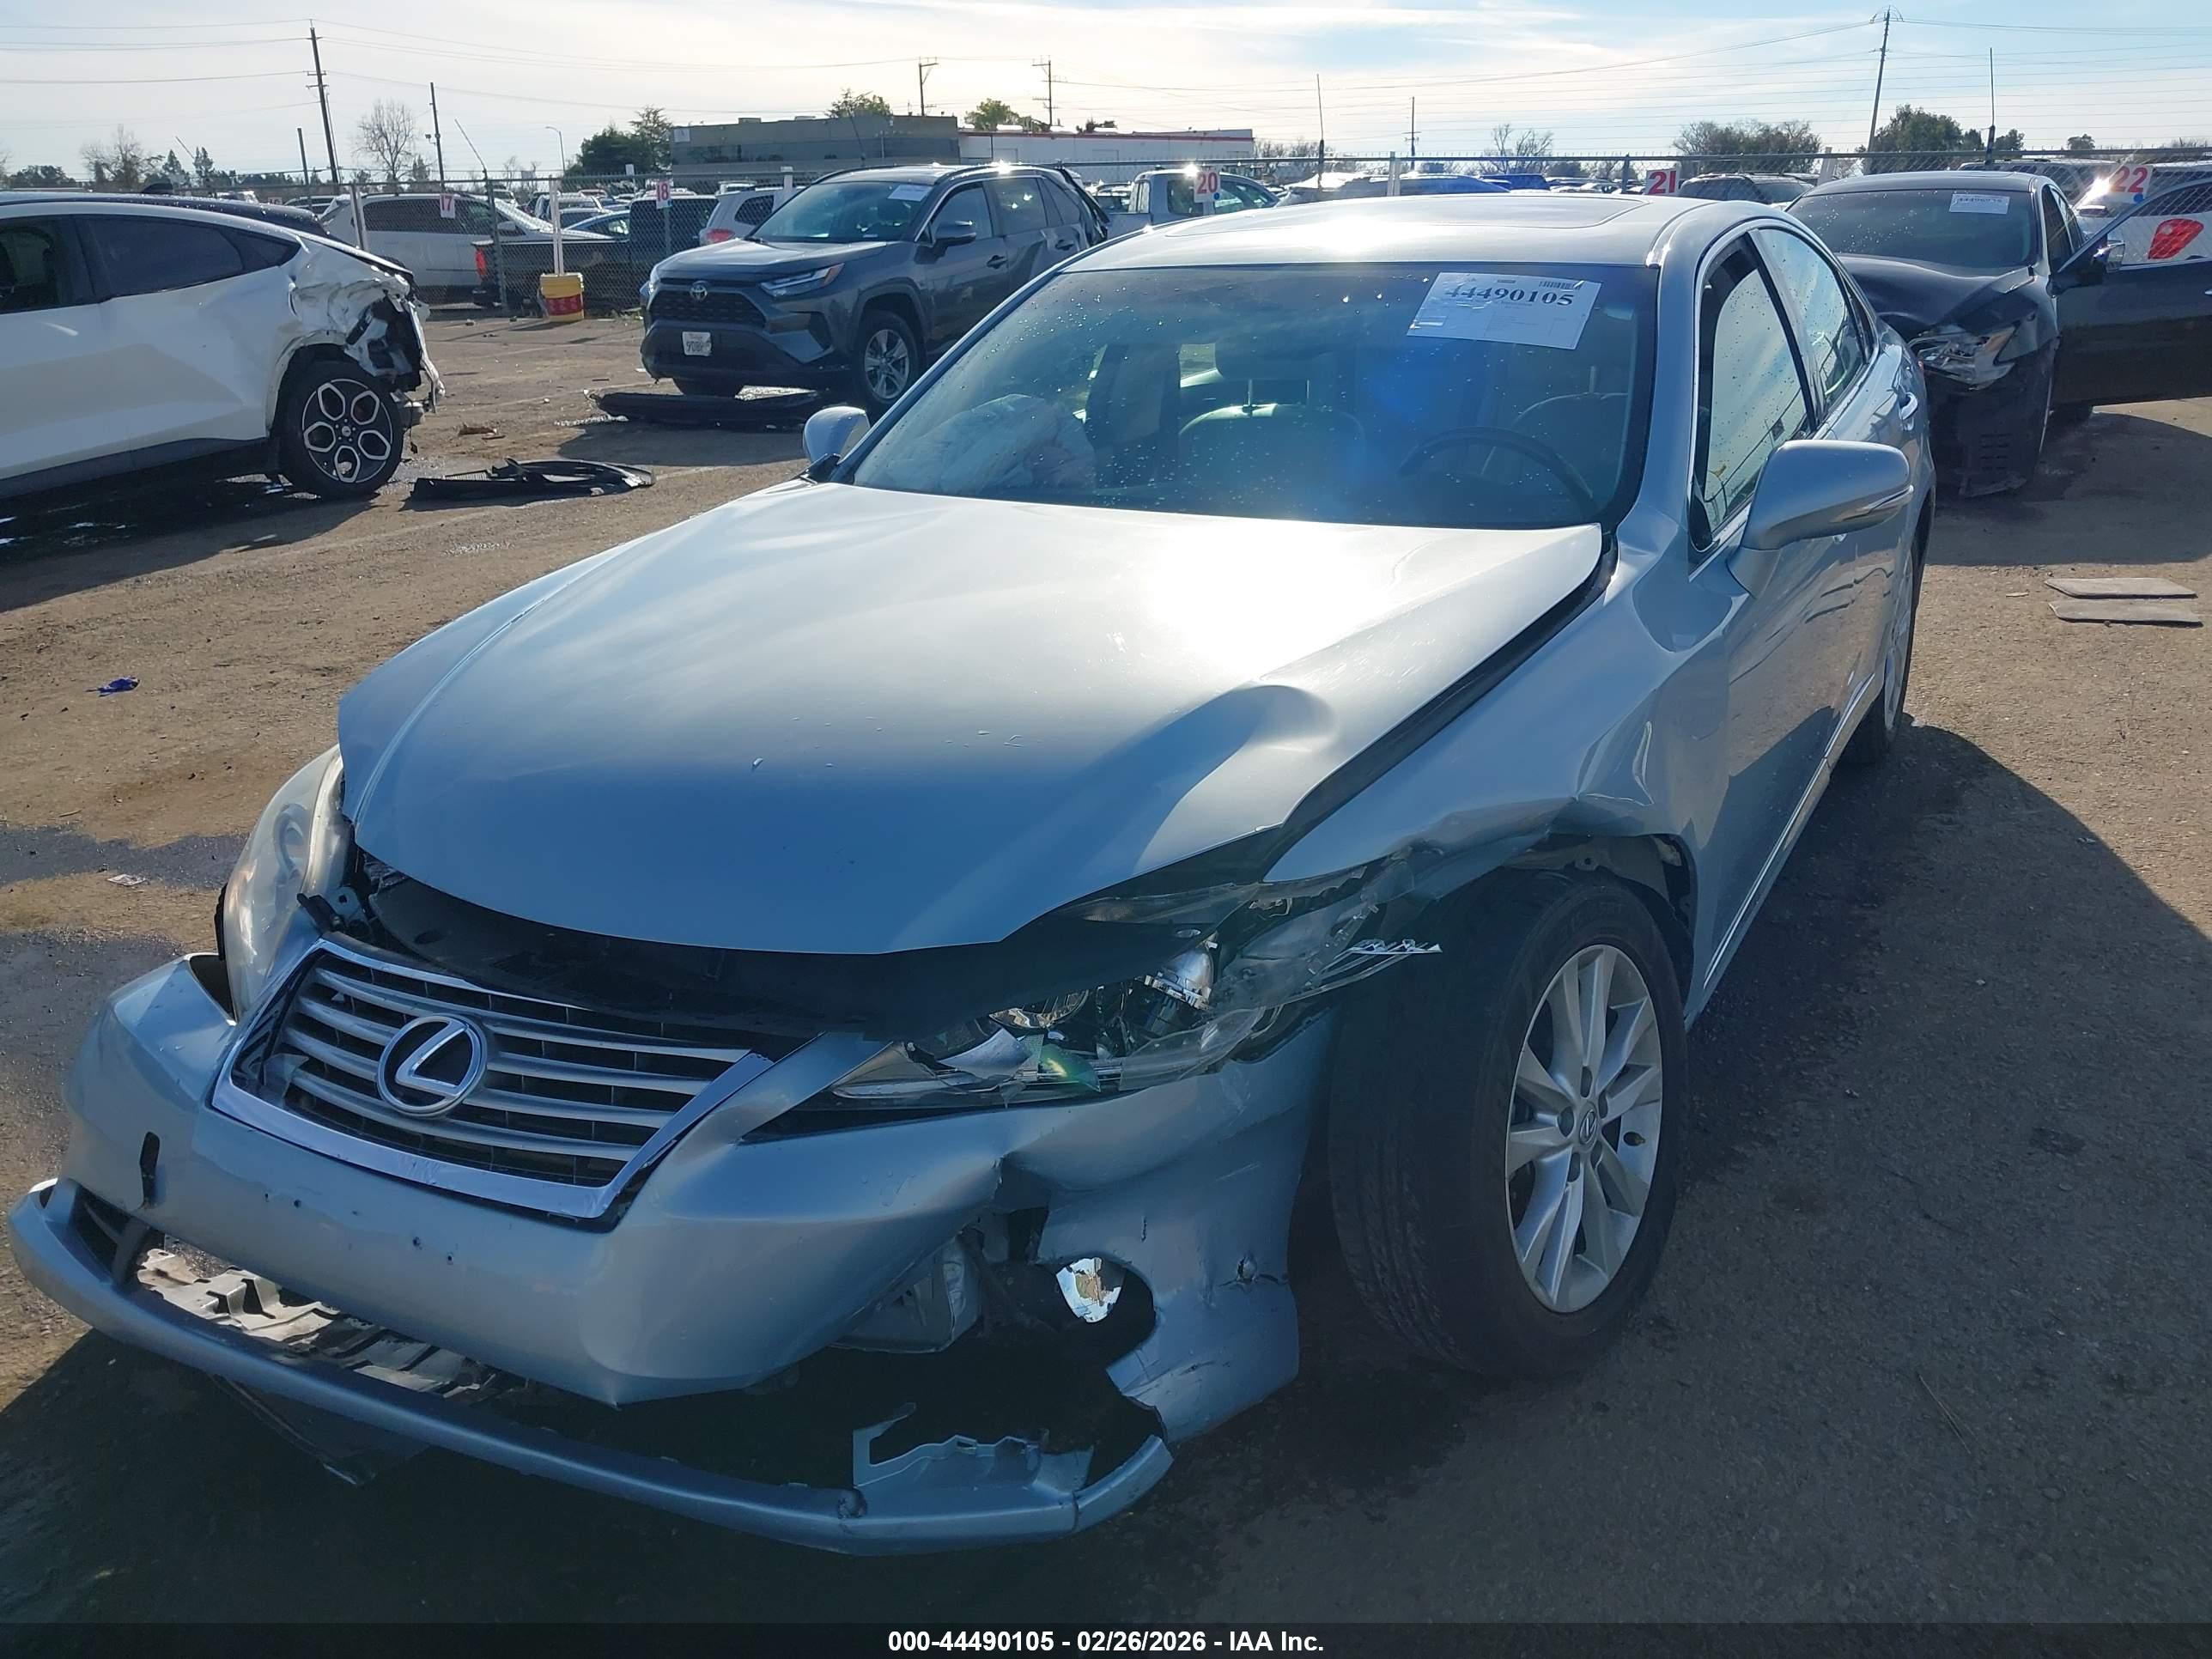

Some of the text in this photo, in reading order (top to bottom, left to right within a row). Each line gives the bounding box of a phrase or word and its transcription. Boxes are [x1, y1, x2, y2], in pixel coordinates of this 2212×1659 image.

[1196, 172, 1218, 194] 20
[1648, 171, 1677, 195] 21
[2112, 166, 2148, 193] 22
[656, 183, 669, 201] 18
[1445, 284, 1575, 307] 44490105
